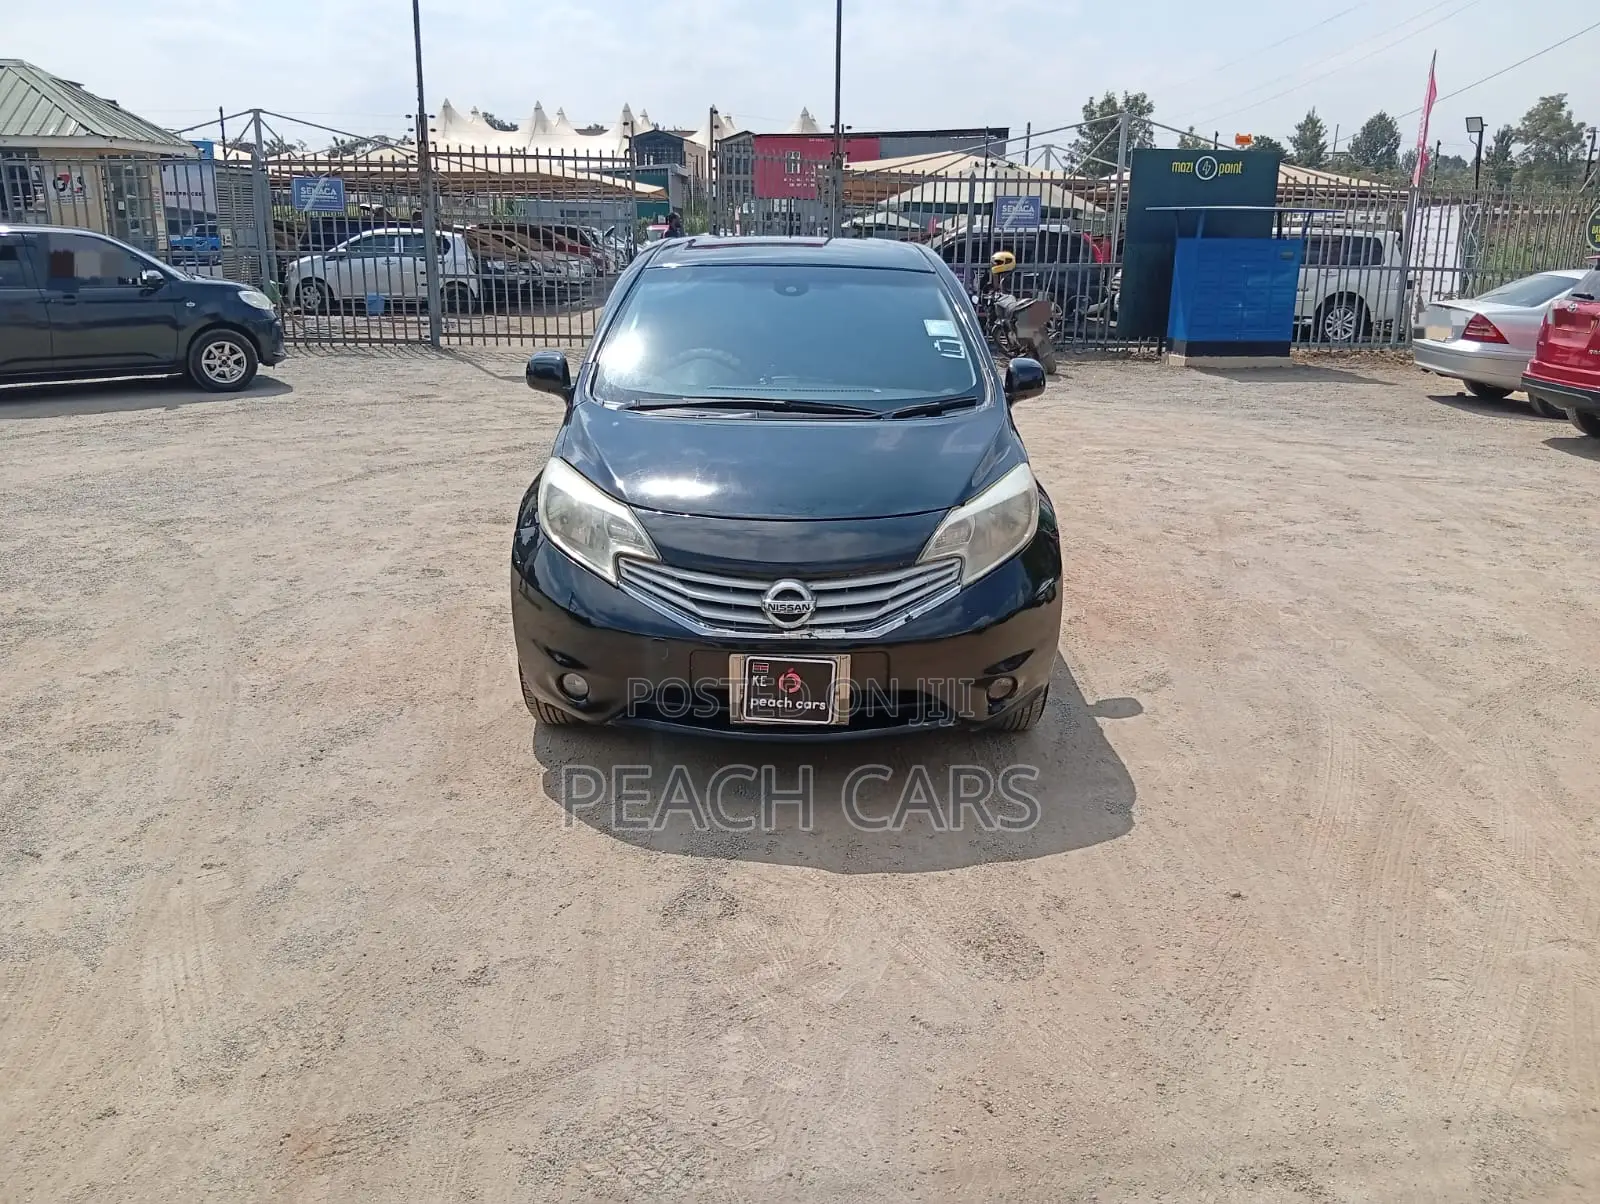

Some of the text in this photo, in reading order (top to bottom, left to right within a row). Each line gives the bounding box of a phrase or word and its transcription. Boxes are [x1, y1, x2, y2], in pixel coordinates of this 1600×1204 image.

[1217, 160, 1243, 177] point
[300, 186, 337, 196] SEACA
[1002, 204, 1035, 213] SEACA
[767, 603, 810, 611] NISSAN
[752, 675, 768, 687] KE
[750, 697, 827, 711] peach cars
